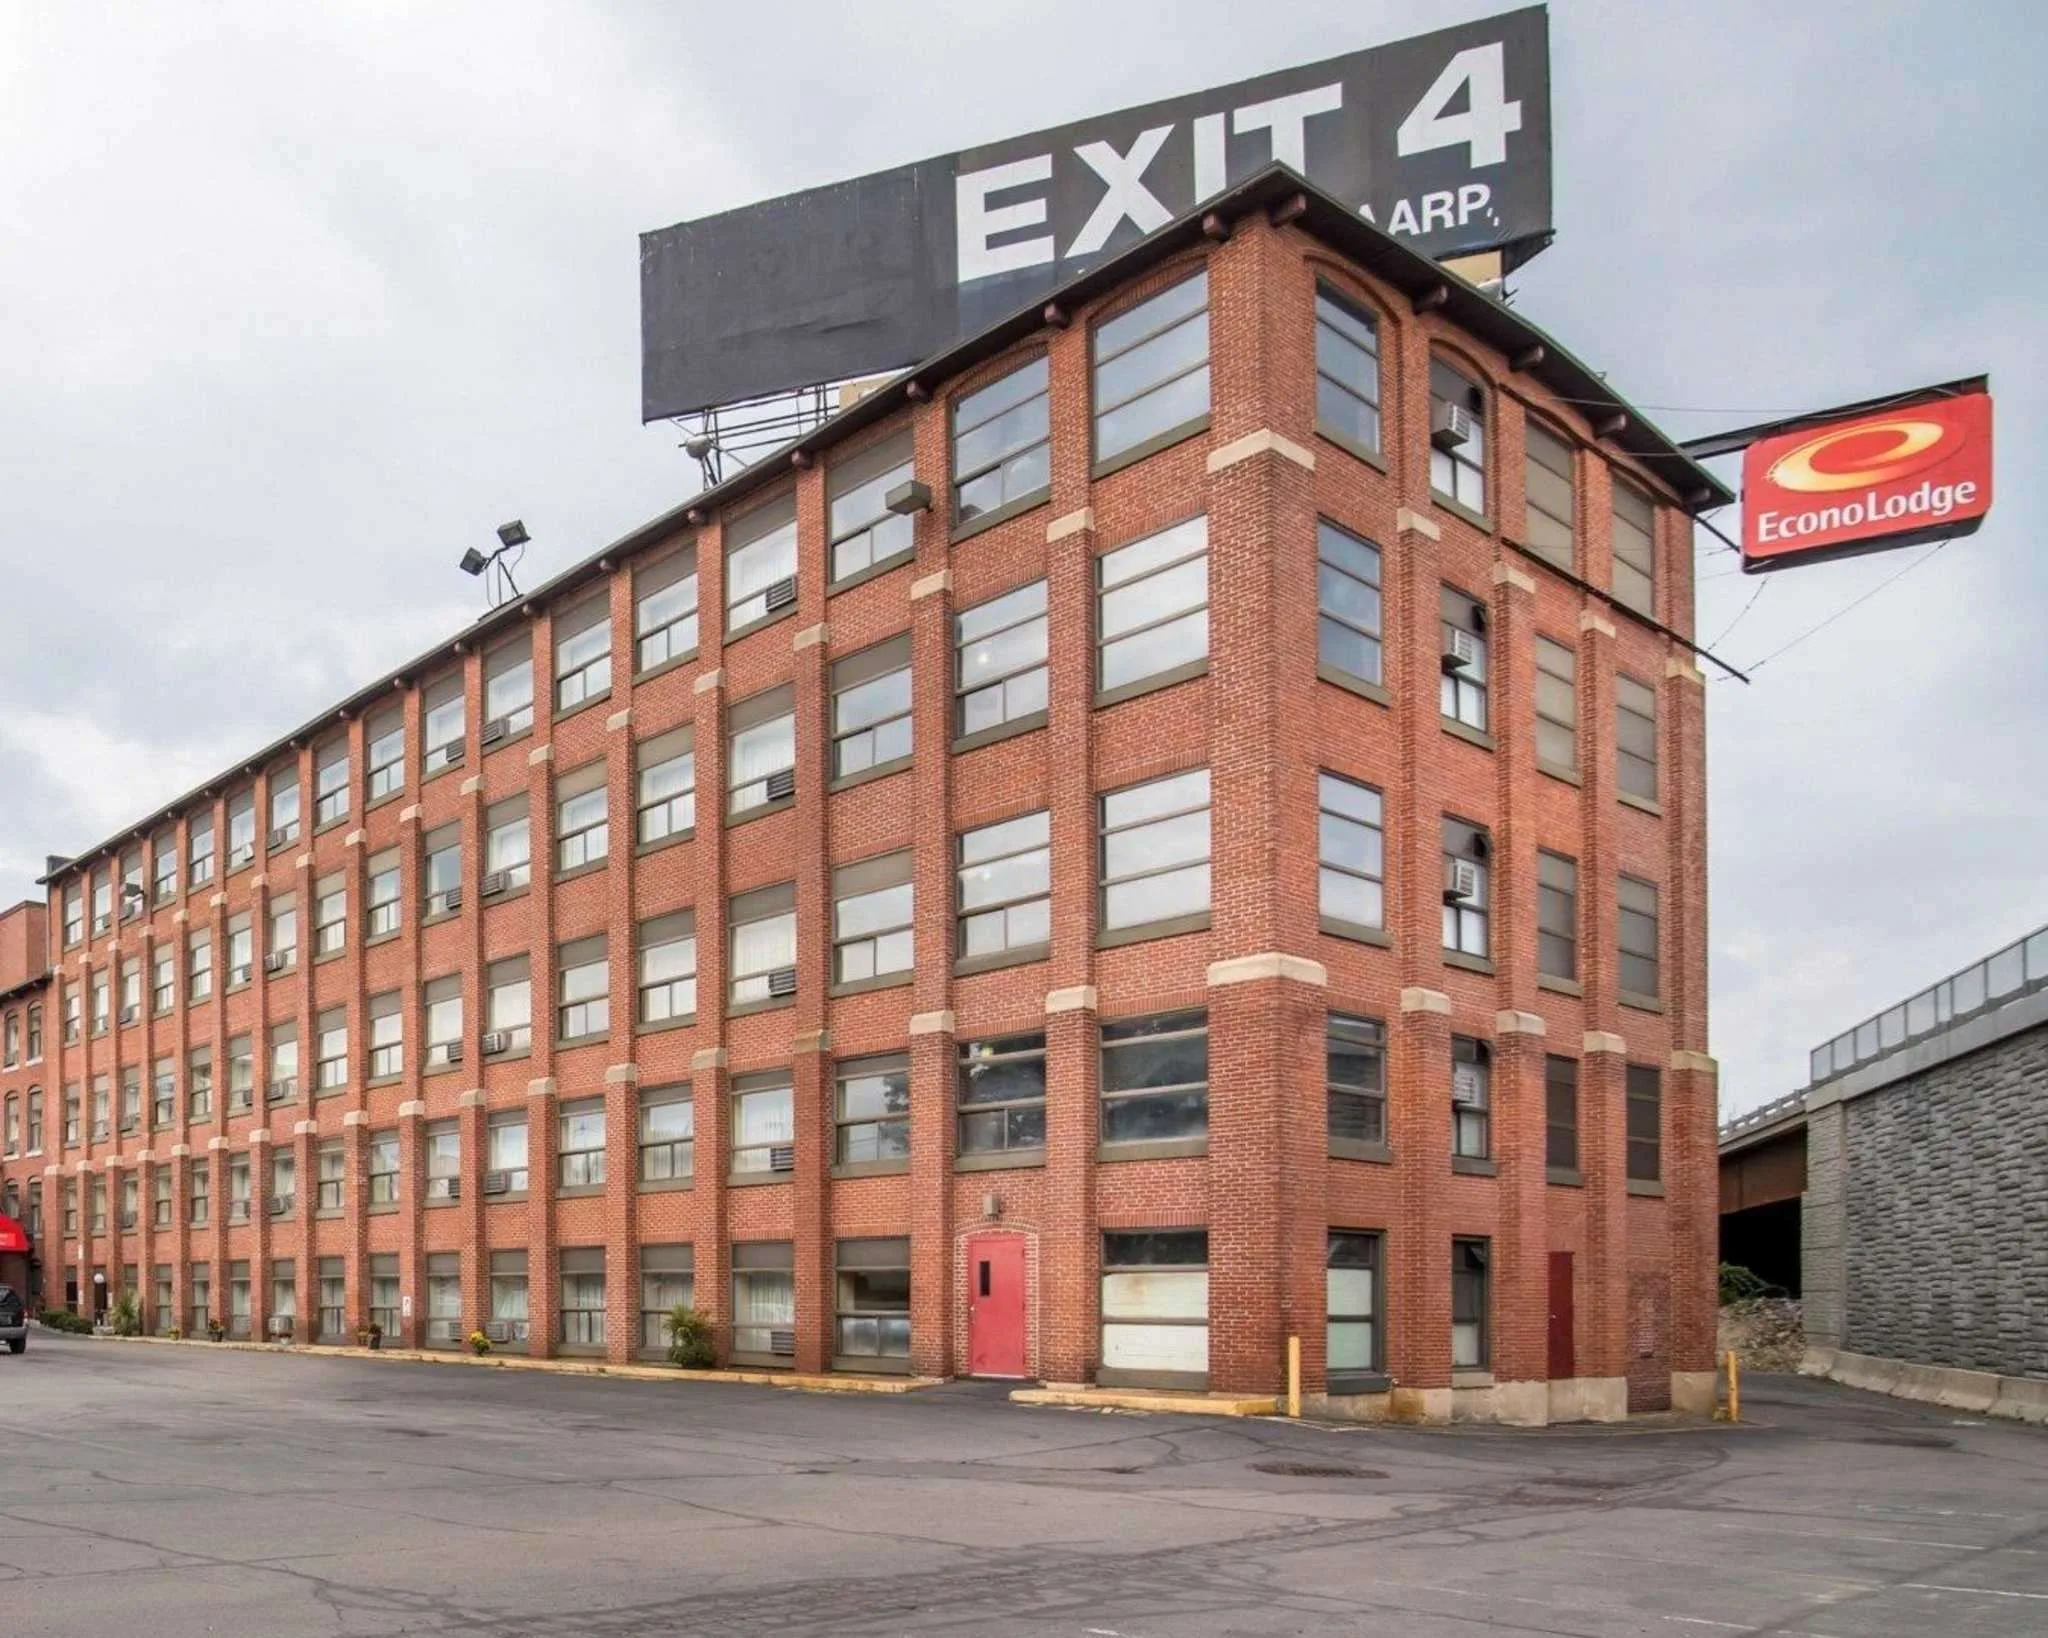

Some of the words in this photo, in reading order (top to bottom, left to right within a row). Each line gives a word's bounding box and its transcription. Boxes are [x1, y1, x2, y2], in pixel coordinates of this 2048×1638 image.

[956, 82, 1343, 283] EXIT
[1397, 41, 1522, 169] 4
[1758, 481, 1976, 542] EconoLodge
